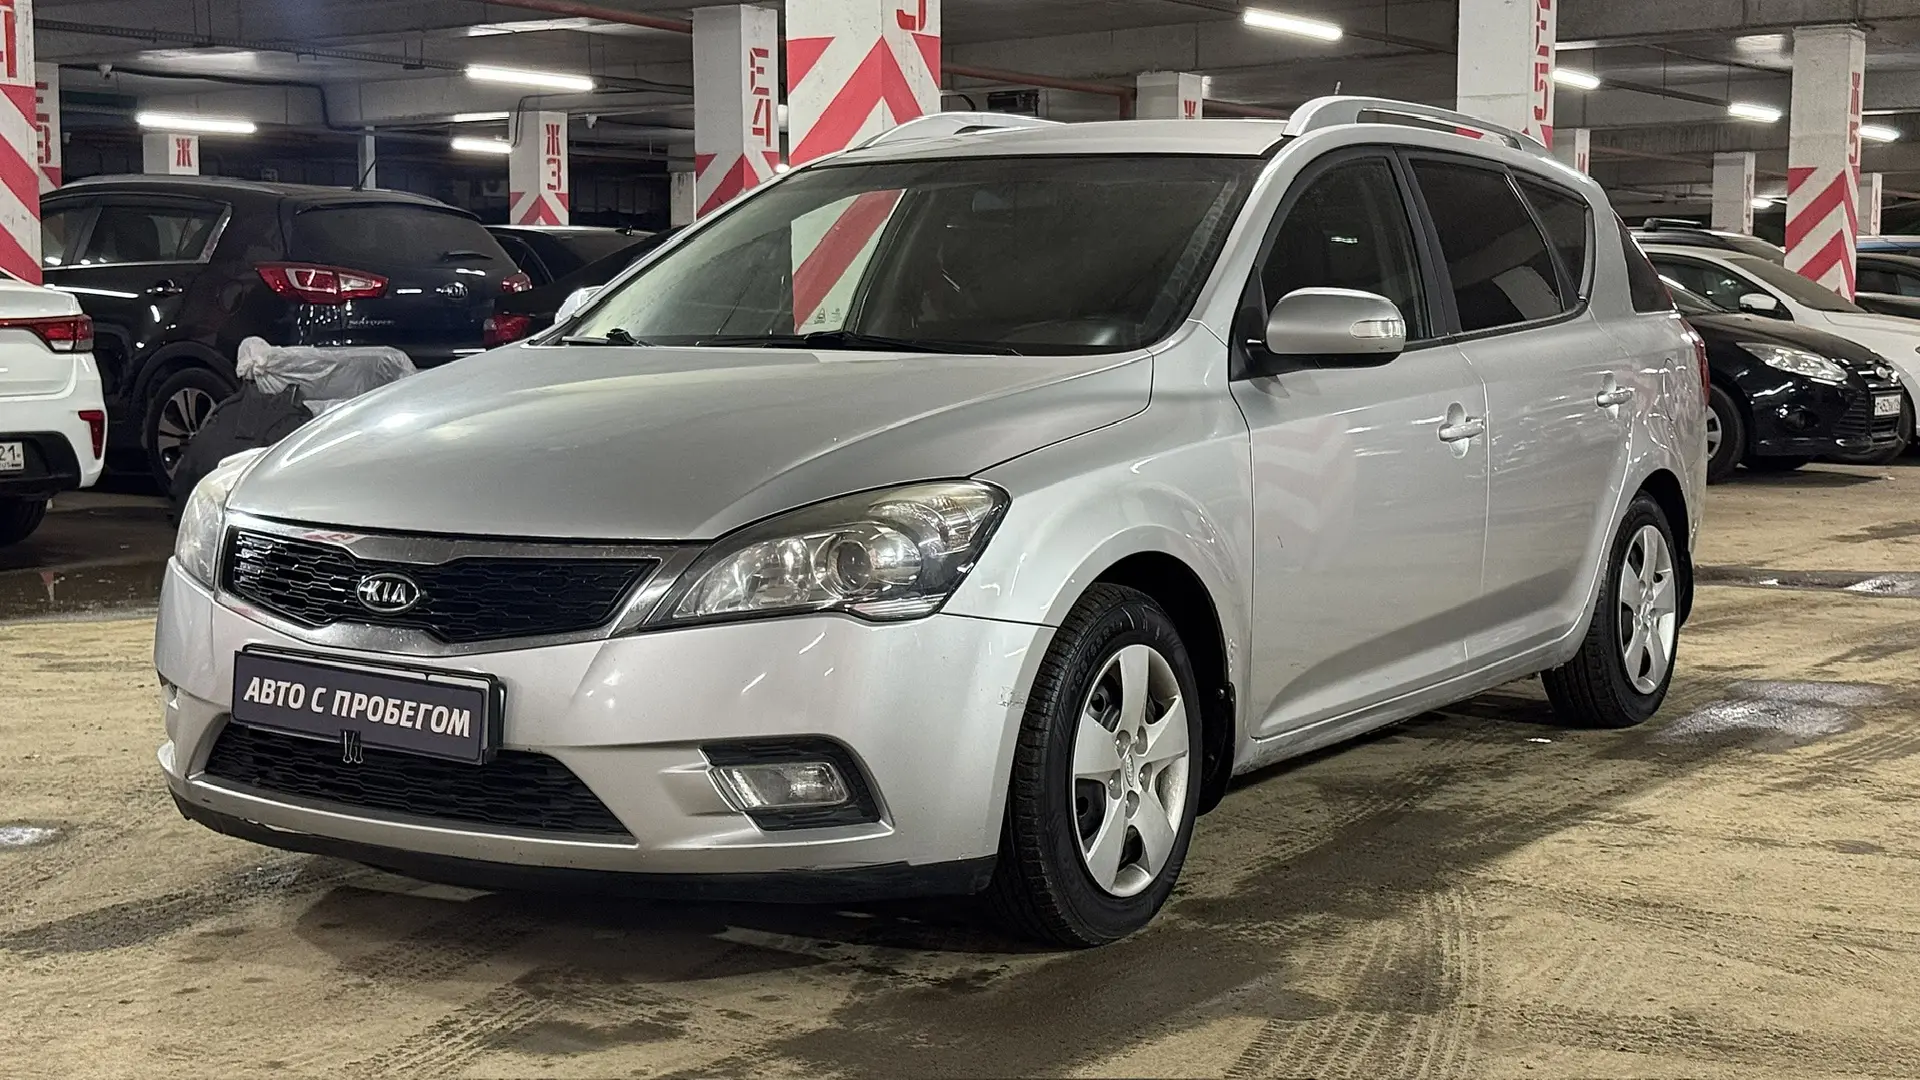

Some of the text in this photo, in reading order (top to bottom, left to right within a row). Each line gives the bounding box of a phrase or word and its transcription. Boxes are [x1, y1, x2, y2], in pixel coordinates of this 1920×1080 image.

[176, 138, 192, 167] Ж
[366, 580, 406, 604] KIA
[243, 676, 471, 738] АВТО С ПРОБЕГОМ
